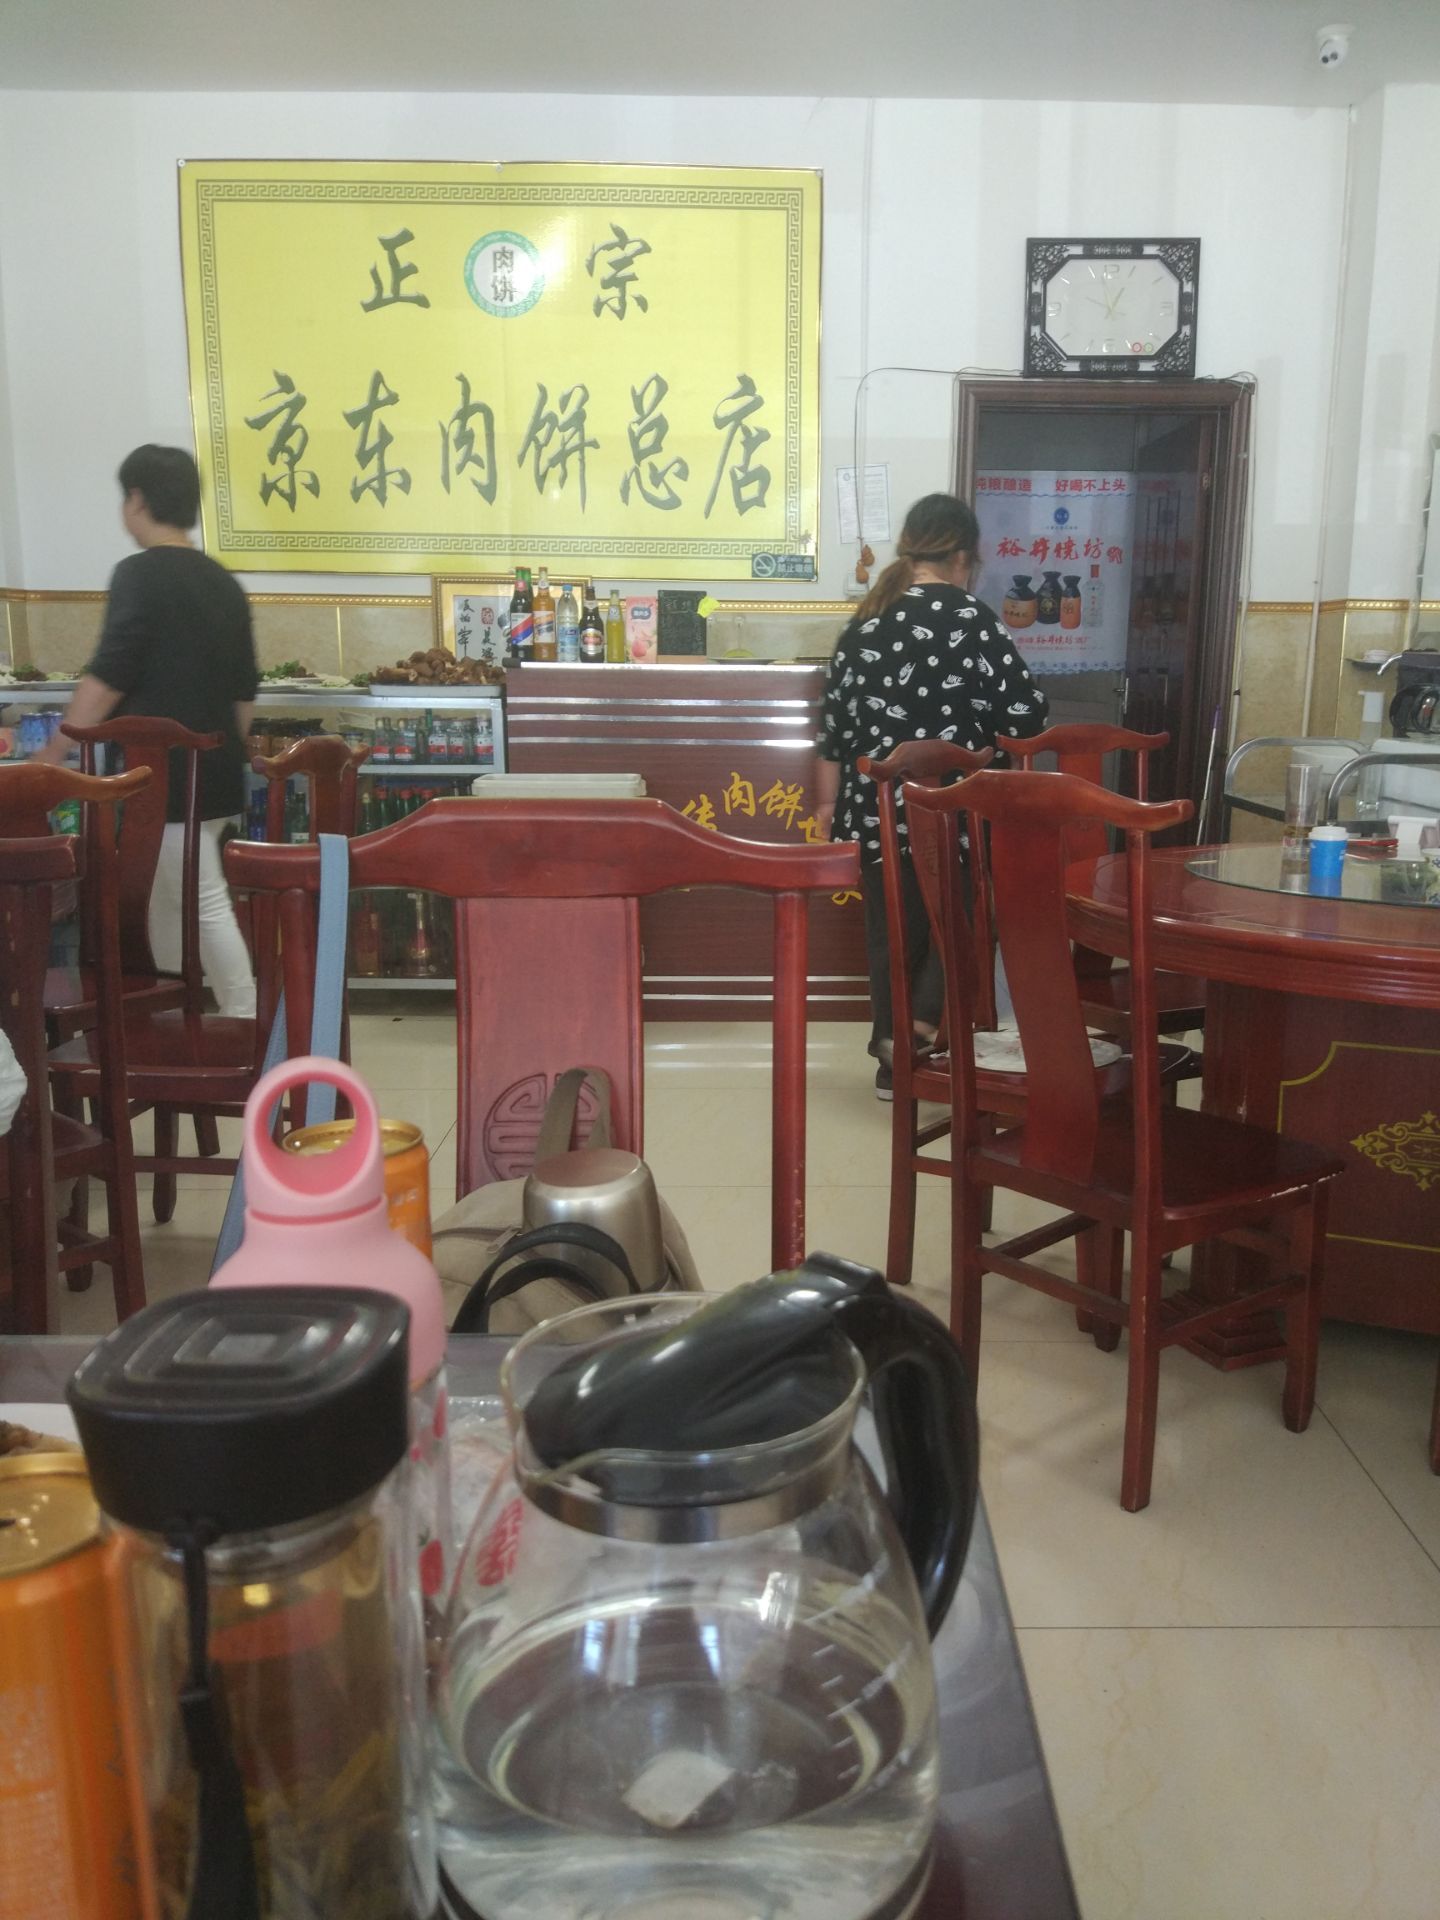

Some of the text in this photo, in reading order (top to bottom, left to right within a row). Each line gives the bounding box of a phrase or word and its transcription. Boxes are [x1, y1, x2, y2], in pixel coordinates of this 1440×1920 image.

[361, 227, 431, 313] 正
[490, 246, 521, 302] 肉饼
[585, 223, 652, 321] 宗
[244, 369, 773, 519] 京东肉饼总店
[1055, 478, 1126, 492] 好喝不上头
